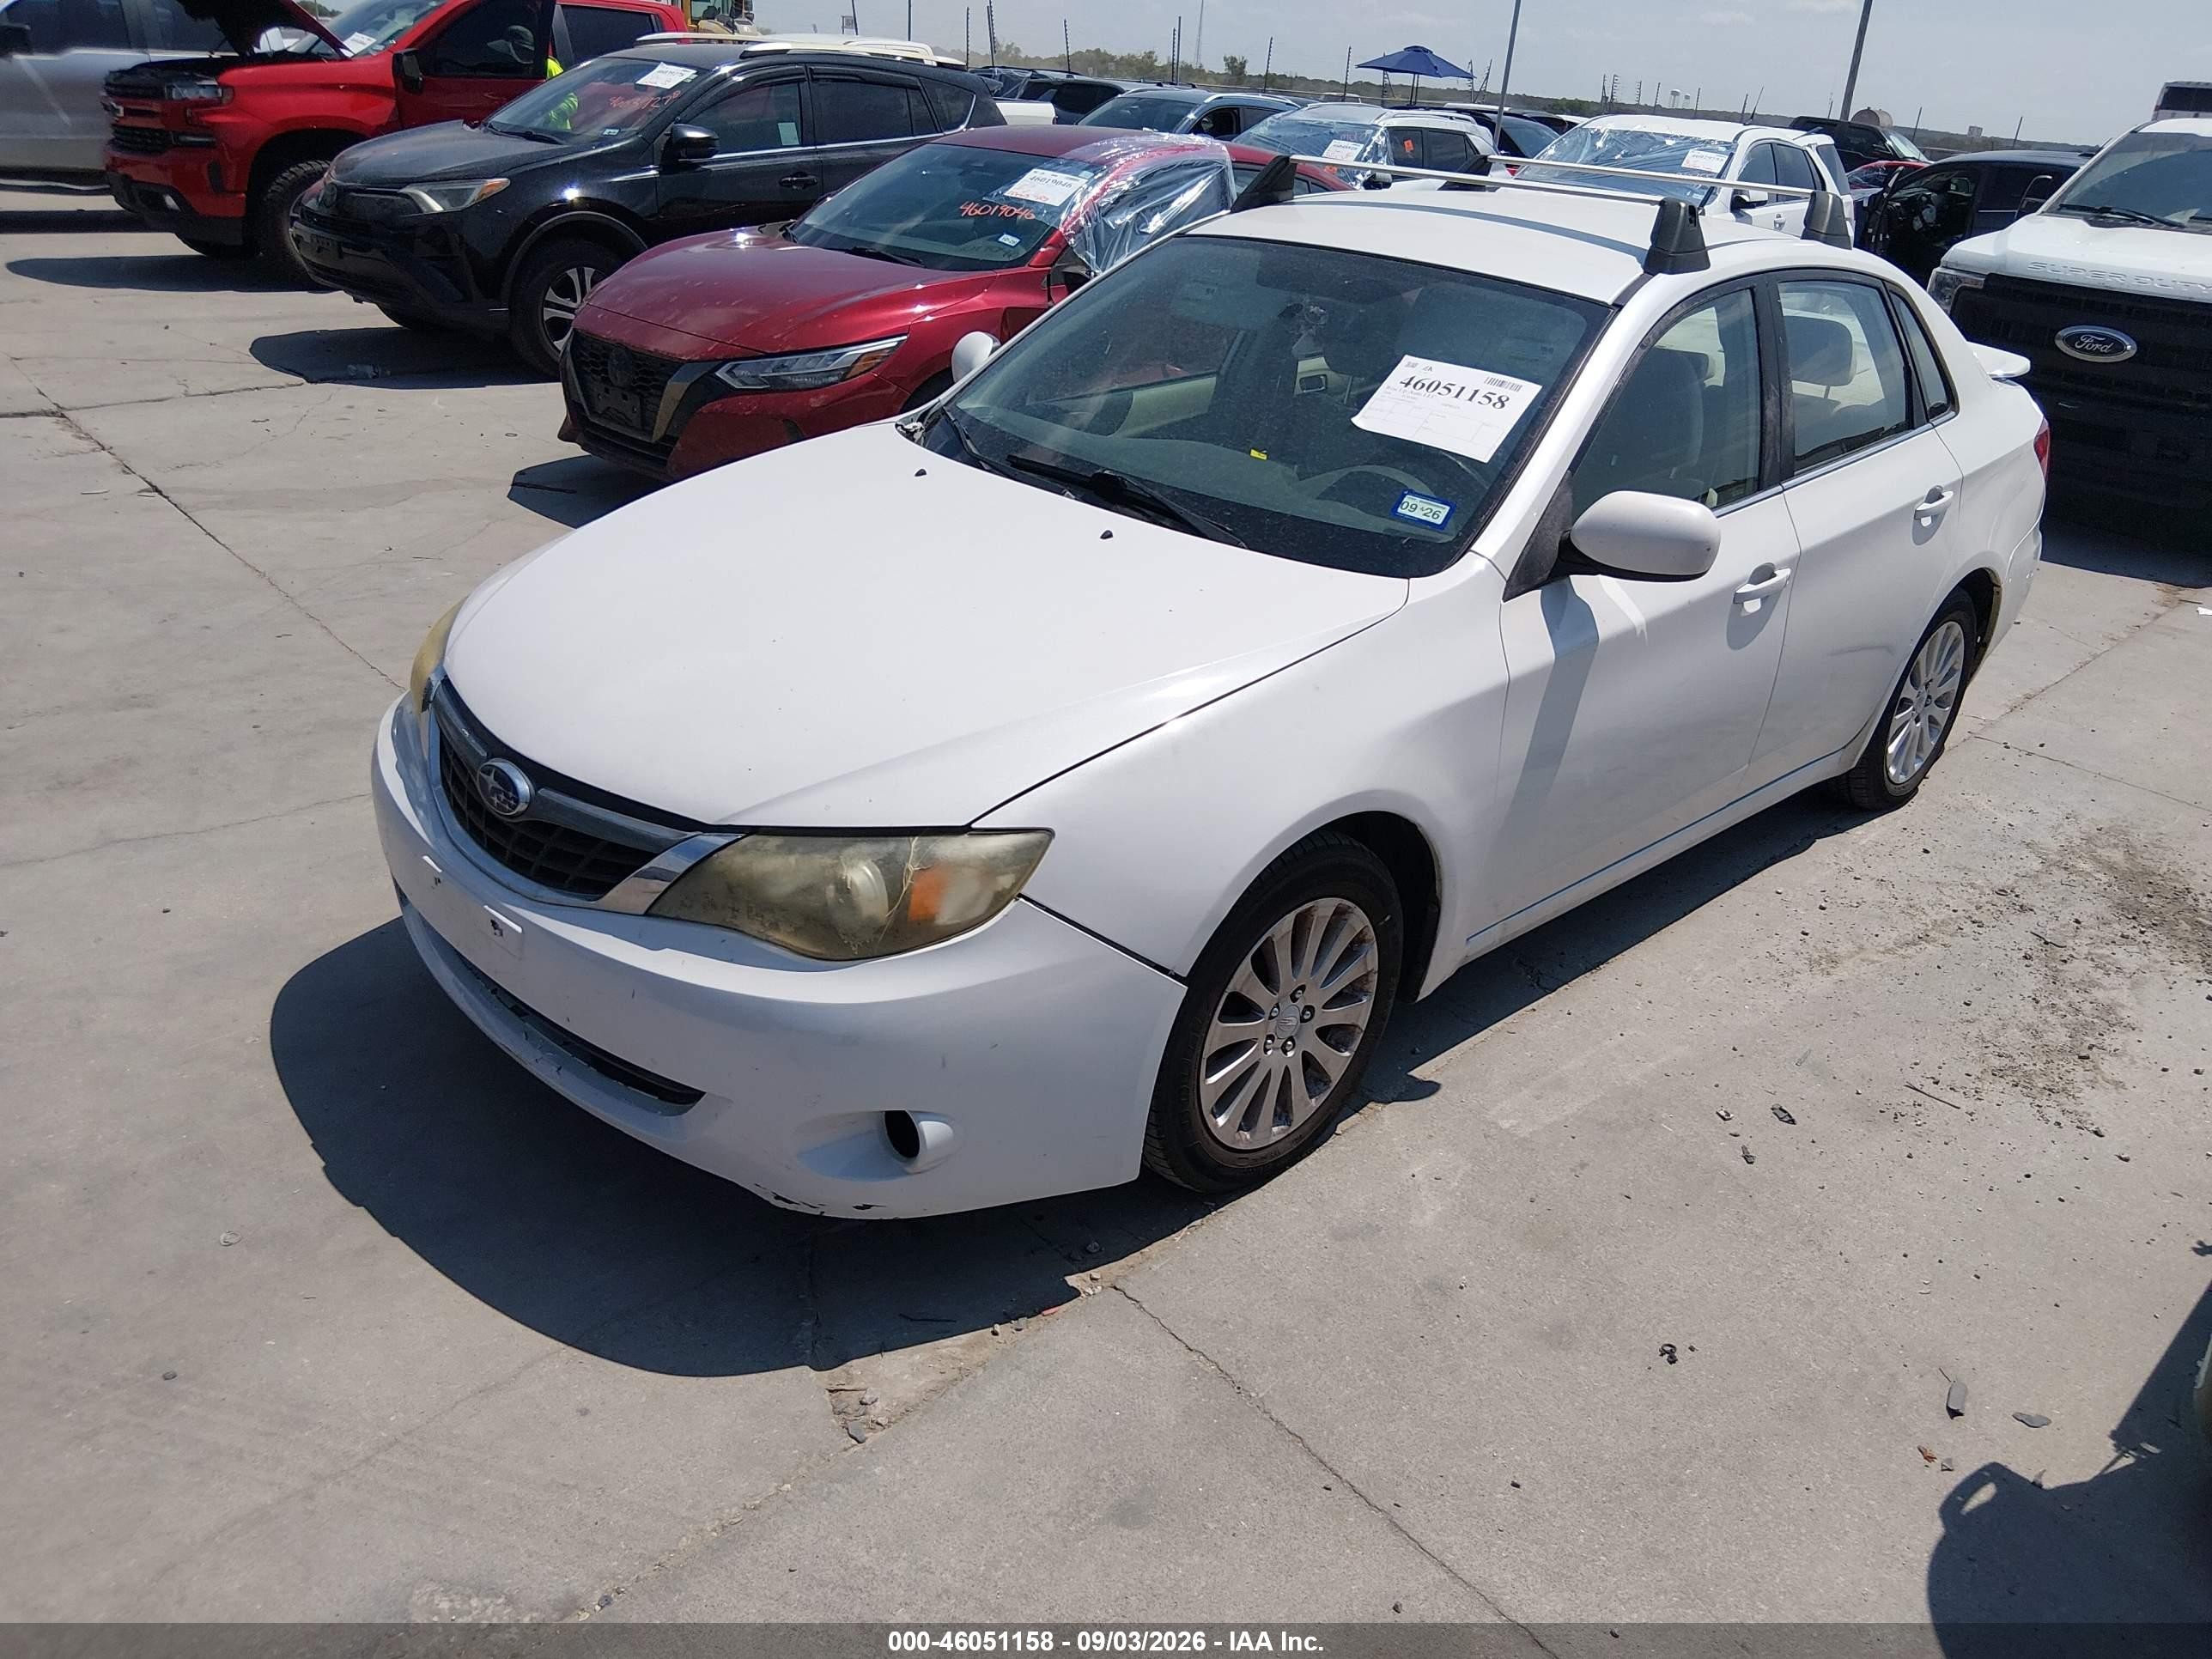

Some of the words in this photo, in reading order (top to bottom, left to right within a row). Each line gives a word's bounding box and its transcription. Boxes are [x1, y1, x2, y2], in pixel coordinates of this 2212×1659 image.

[1030, 175, 1073, 189] 46019046
[960, 201, 1036, 220] 46019046
[2027, 261, 2127, 282] SUPER
[2133, 275, 2212, 294] DUTY
[2074, 334, 2114, 354] Ford
[1399, 375, 1510, 410] 46051158
[1401, 501, 1419, 513] 09
